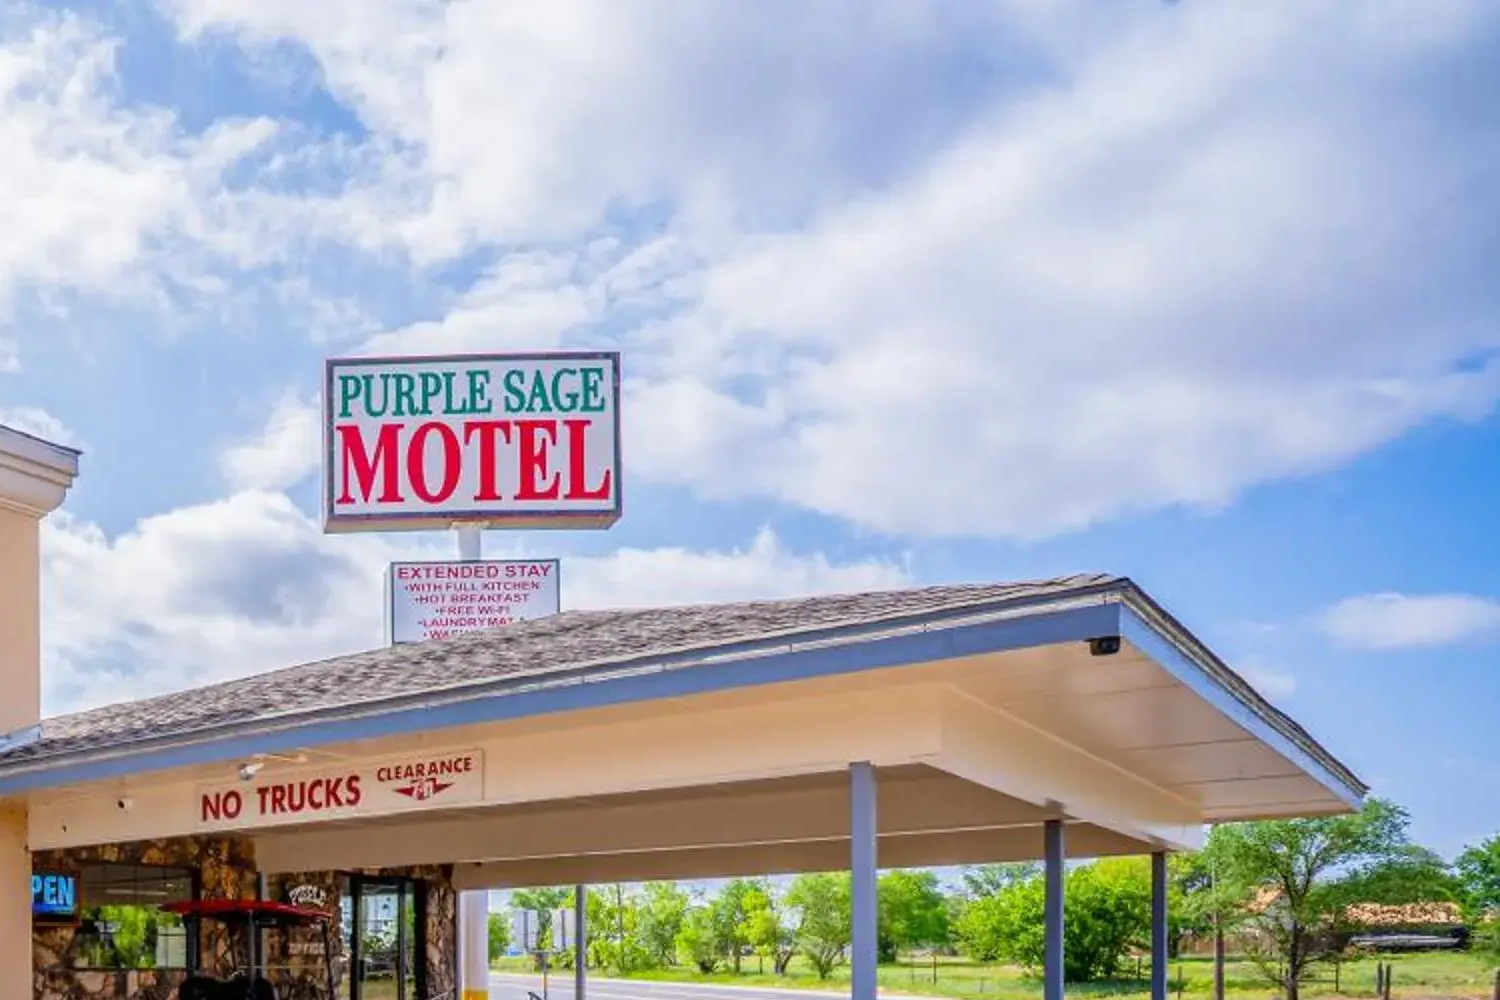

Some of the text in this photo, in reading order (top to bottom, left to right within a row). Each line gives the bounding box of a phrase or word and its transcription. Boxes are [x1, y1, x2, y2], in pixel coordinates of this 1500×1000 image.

[339, 367, 605, 417] PURPLE SAGE
[336, 419, 611, 504] MOTEL
[398, 565, 551, 579] EXTENDED STAY
[408, 581, 539, 592] WITH FULL KITCHEN
[420, 593, 529, 603] HOT BREAKFAST
[440, 606, 474, 615] FREE
[377, 757, 472, 782] CLEARANCE
[202, 775, 361, 821] NO TRUCKS
[31, 874, 75, 906] PEN
